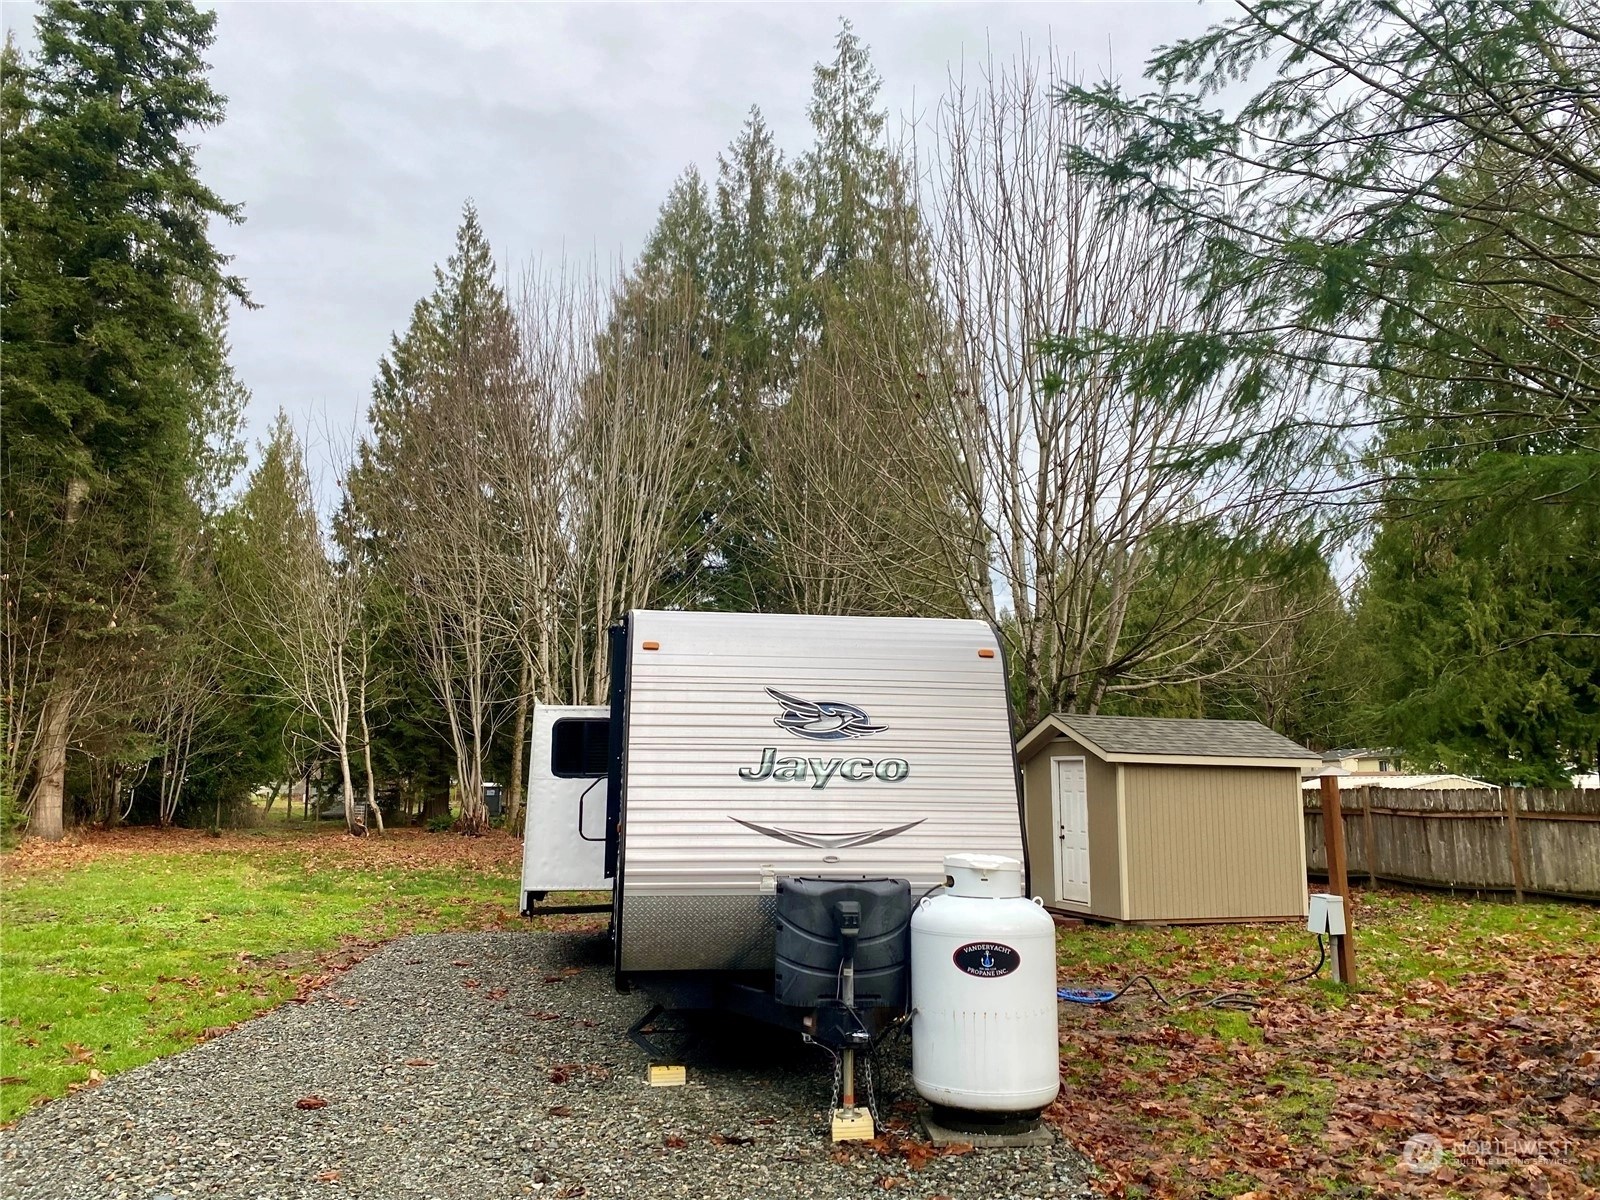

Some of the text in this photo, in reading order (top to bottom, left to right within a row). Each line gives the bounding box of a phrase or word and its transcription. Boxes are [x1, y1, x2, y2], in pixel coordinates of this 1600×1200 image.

[738, 747, 910, 790] Jayco
[963, 944, 1012, 955] VANDERYACHT
[967, 966, 996, 977] PROPANE
[996, 968, 1009, 976] INC.
